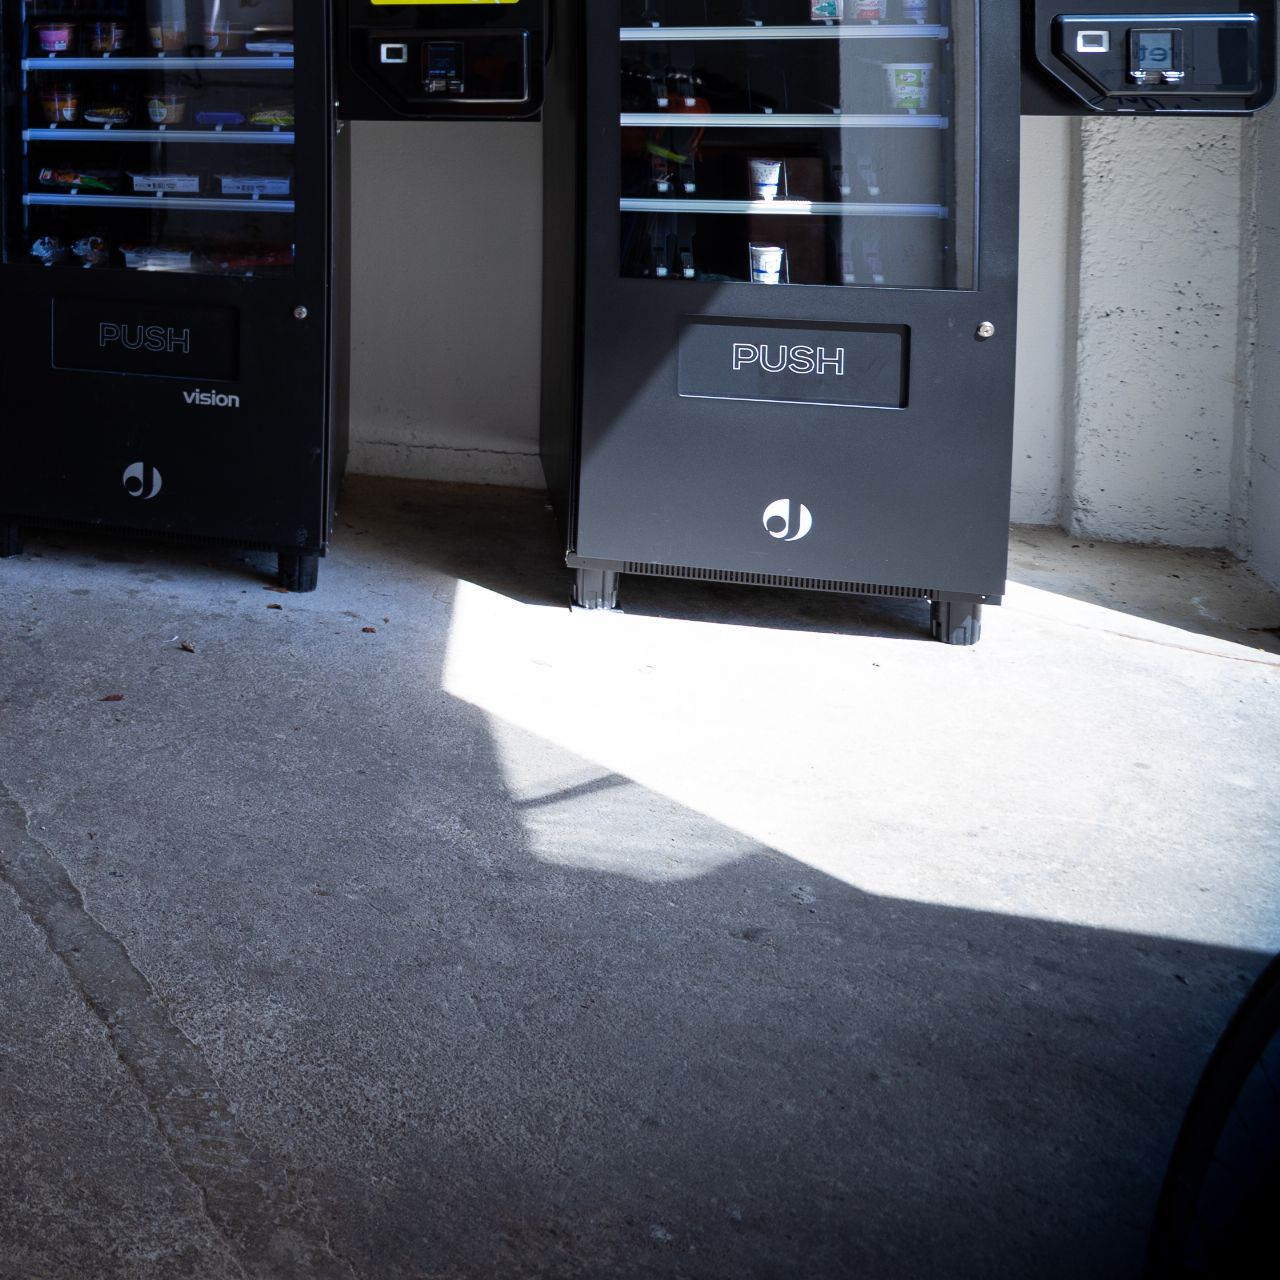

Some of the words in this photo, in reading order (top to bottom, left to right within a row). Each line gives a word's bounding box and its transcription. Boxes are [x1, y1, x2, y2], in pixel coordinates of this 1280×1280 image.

[99, 322, 191, 354] PUSH
[732, 343, 845, 377] PUSH
[183, 388, 241, 408] vision
